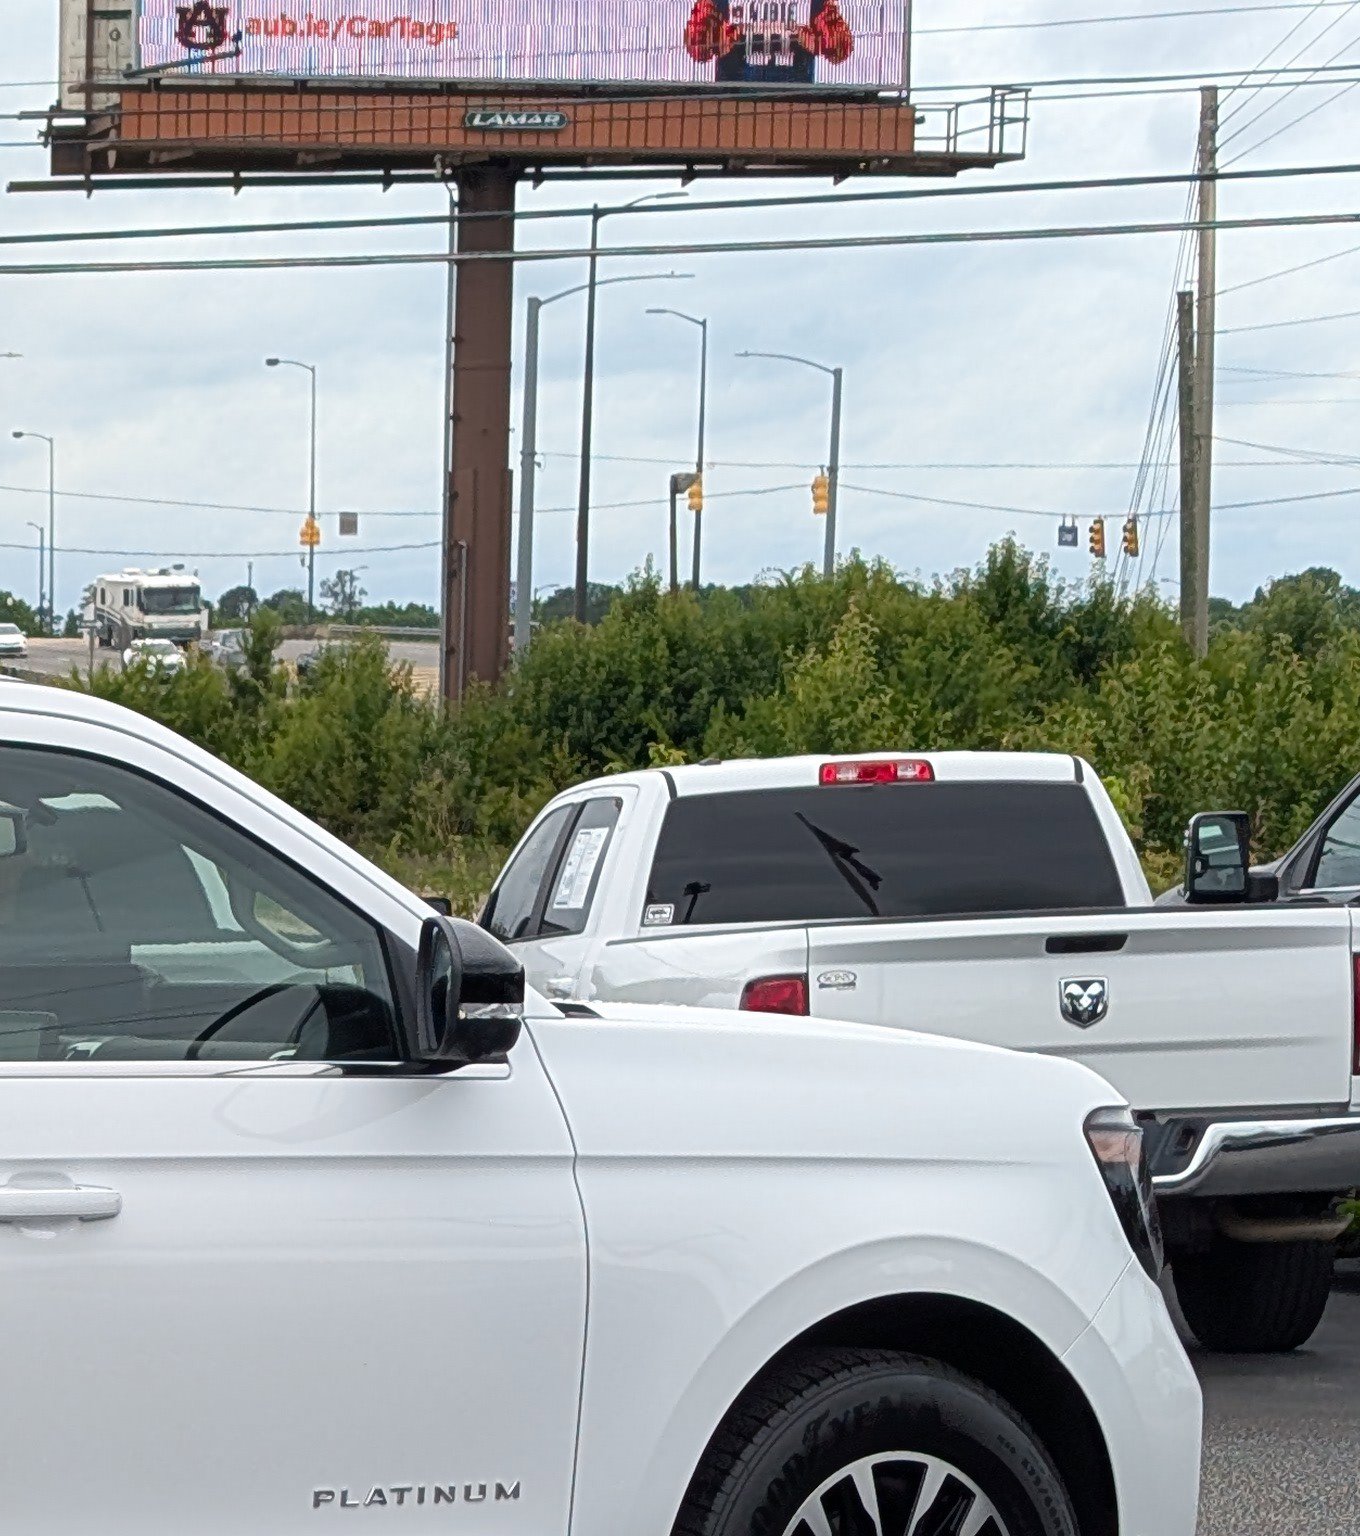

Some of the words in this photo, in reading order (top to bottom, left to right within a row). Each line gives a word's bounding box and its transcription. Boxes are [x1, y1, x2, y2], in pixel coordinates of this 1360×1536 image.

[245, 12, 458, 46] aub.ie/CarTags
[473, 113, 561, 127] LAMAR
[312, 1480, 521, 1510] PLATINUM
